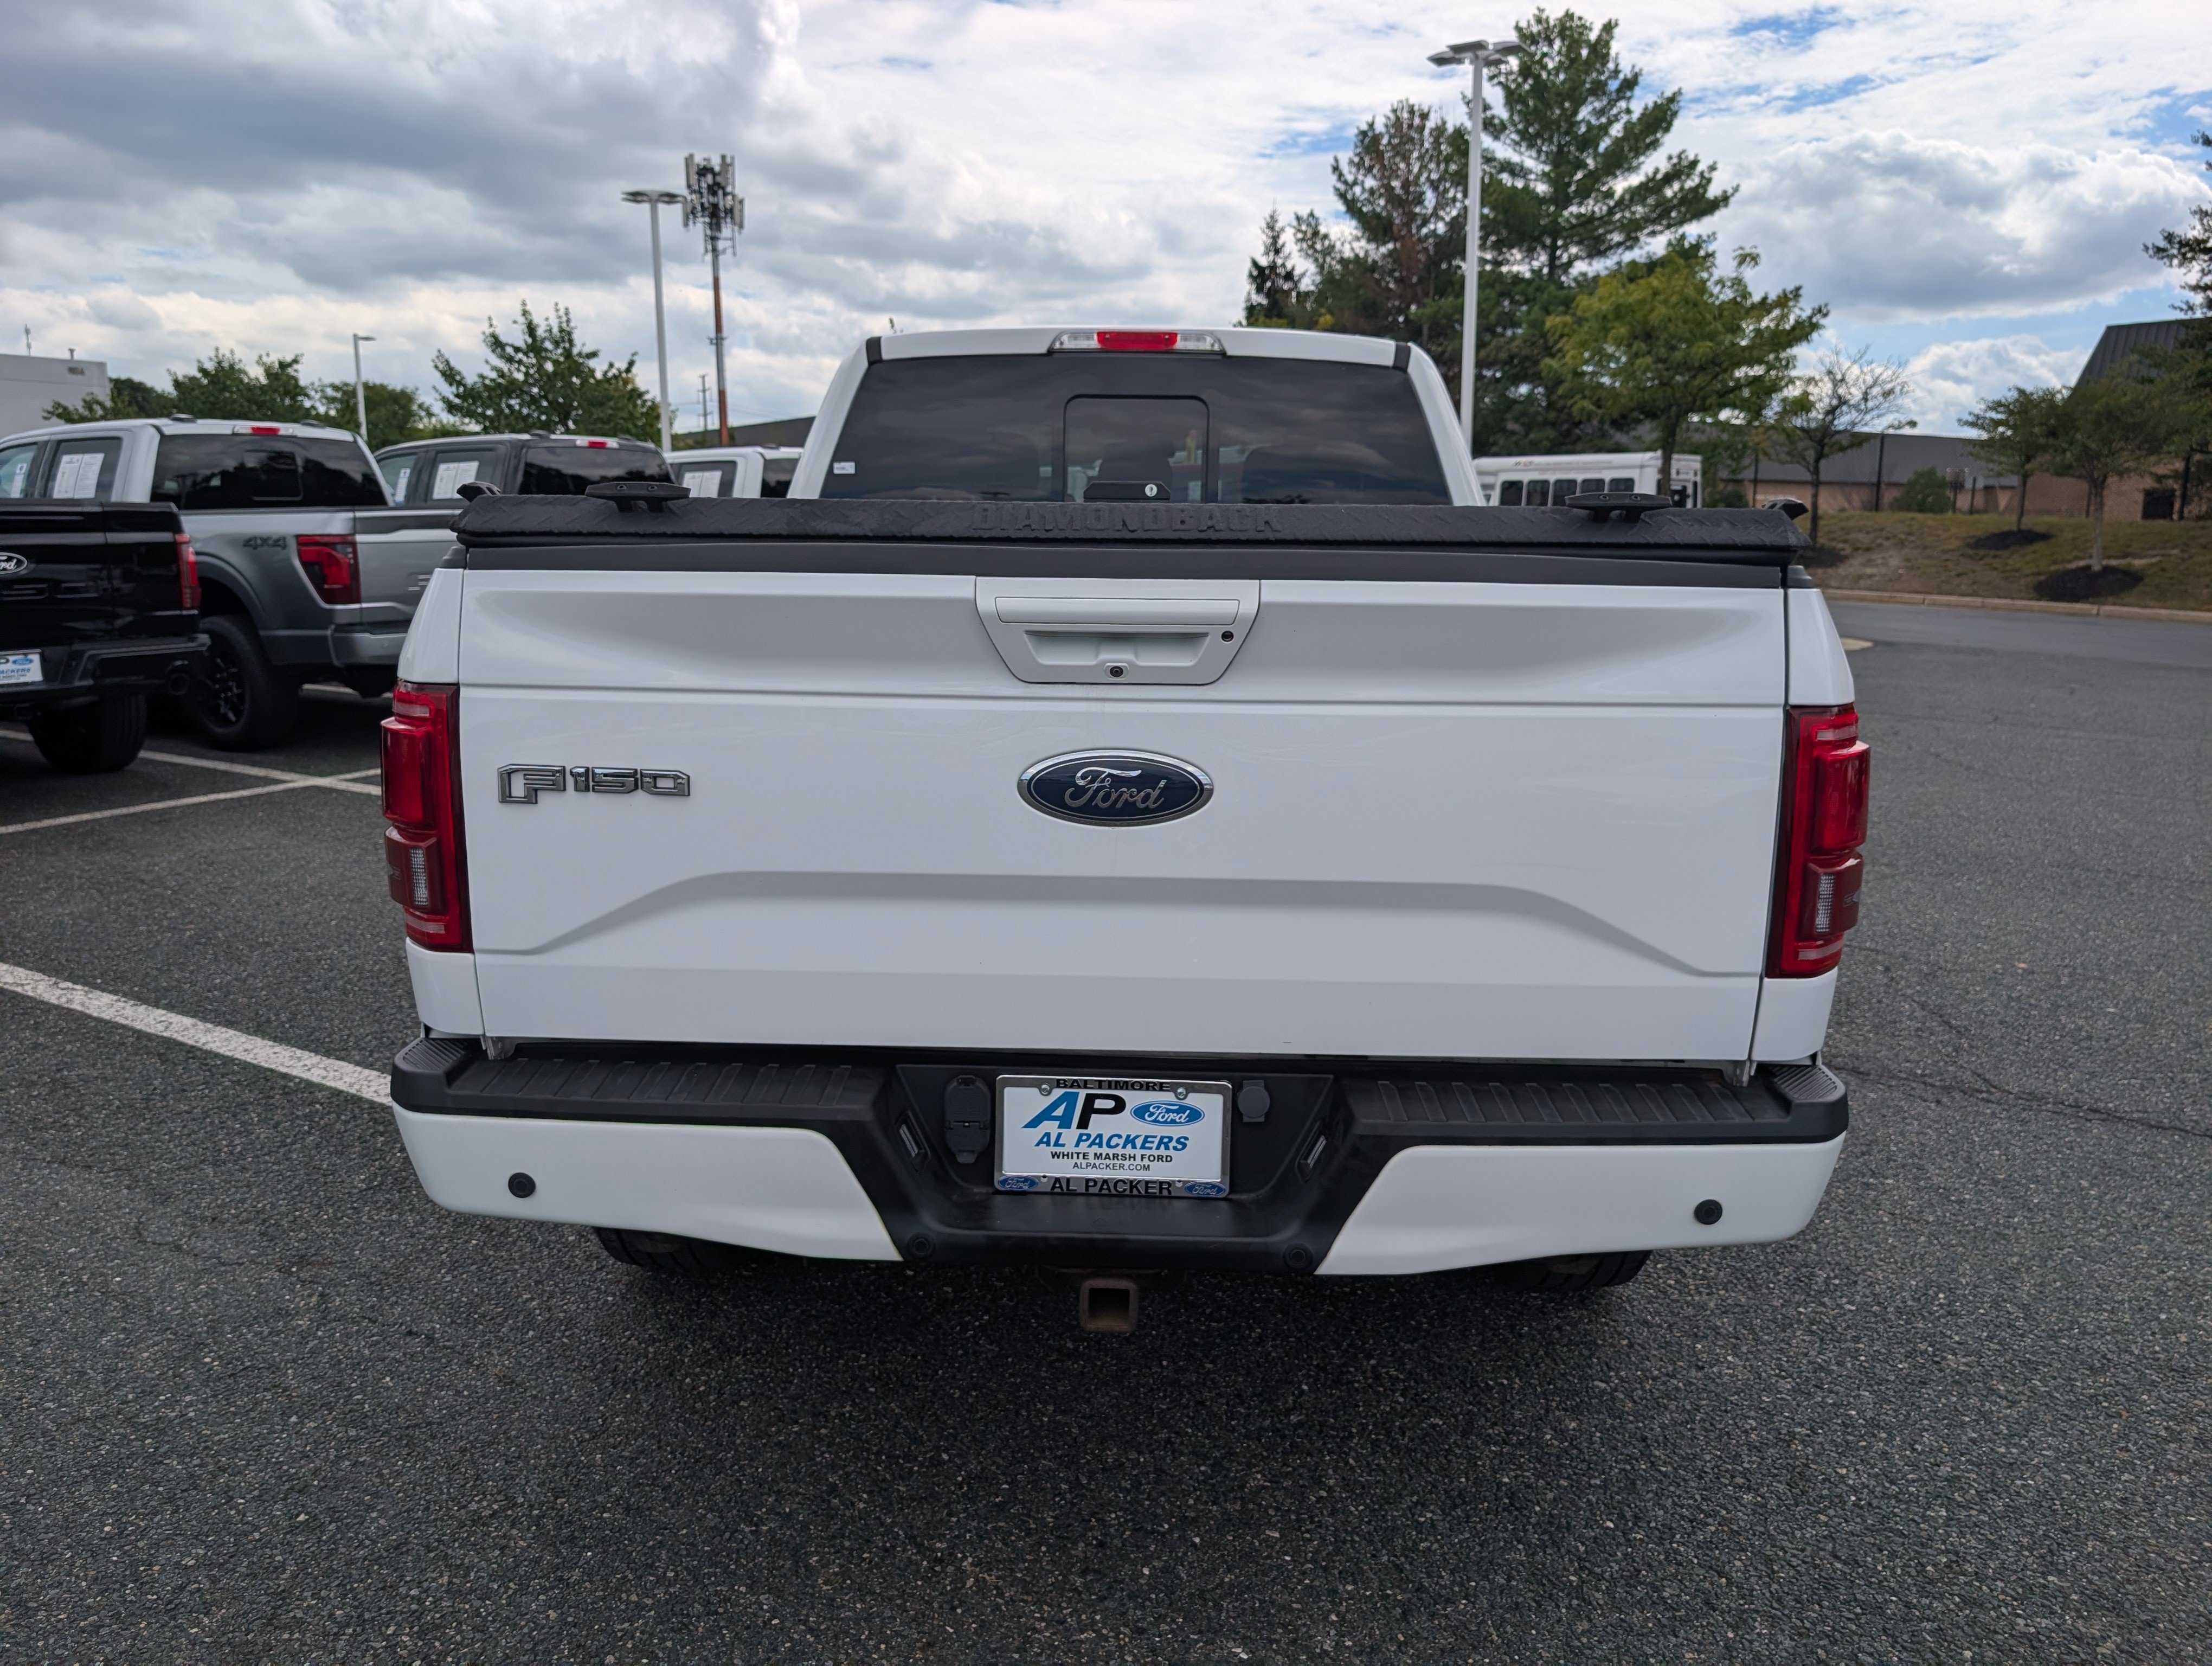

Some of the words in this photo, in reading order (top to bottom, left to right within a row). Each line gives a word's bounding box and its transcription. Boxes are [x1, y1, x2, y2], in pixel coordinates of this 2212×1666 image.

[972, 503, 1281, 533] DIAMONDBACK
[1064, 766, 1167, 808] Ford
[1056, 1078, 1171, 1091] BALTIMORE
[1021, 1091, 1127, 1130] AP
[1144, 1104, 1190, 1124] Ford
[1034, 1131, 1066, 1148] AL
[1075, 1132, 1189, 1151] PACKERS
[1051, 1151, 1090, 1161] WHITE
[1094, 1152, 1137, 1162] MARSH
[1141, 1154, 1173, 1163] FORD
[1072, 1161, 1151, 1172] ALPACKER.COM
[1050, 1176, 1078, 1192] AL
[1085, 1177, 1173, 1195] PACKER
